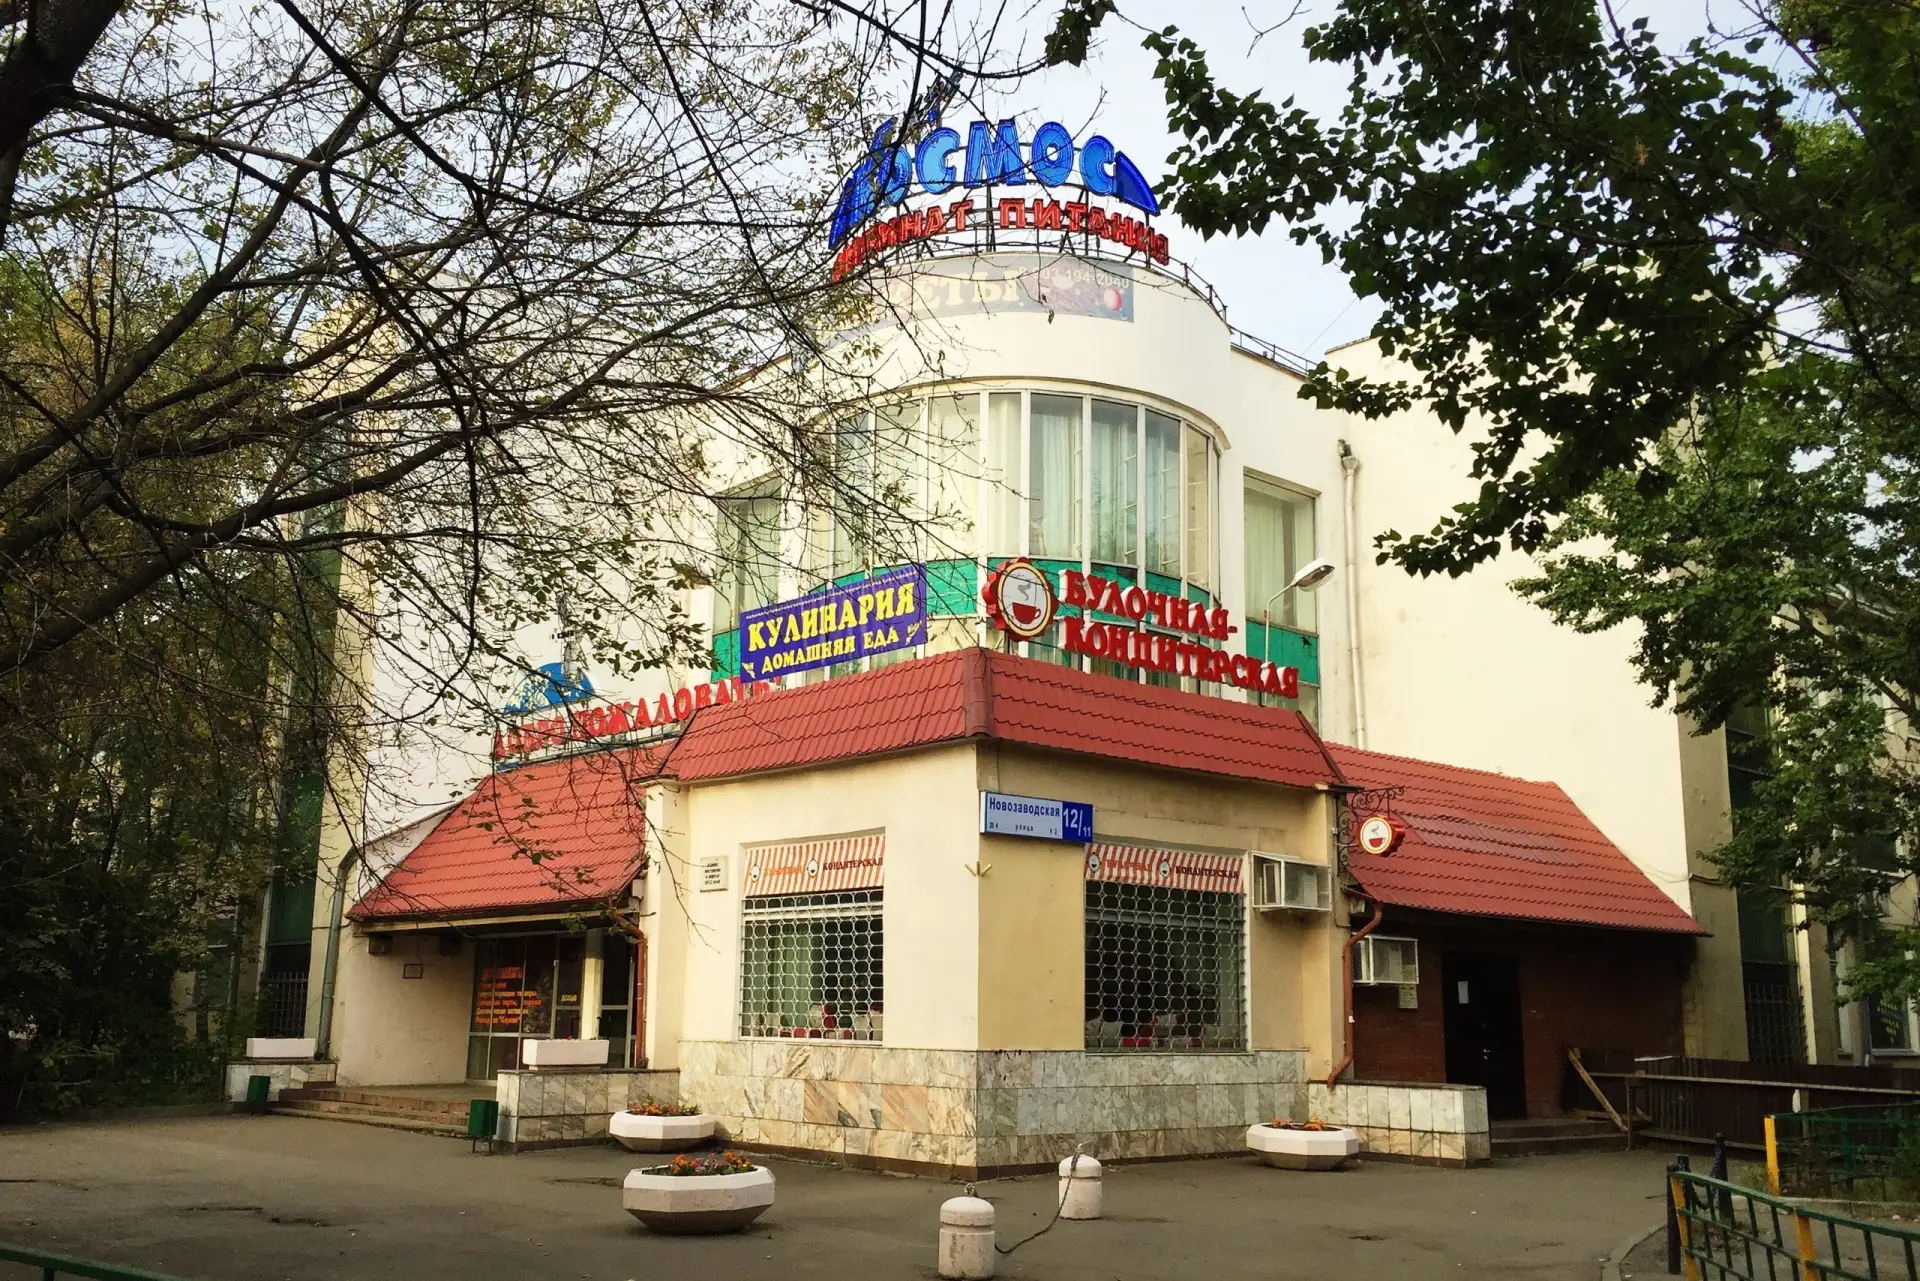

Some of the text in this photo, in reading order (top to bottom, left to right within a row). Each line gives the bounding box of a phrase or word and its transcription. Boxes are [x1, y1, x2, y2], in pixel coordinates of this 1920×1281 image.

[998, 197, 1169, 266] ПИТАНИЯ
[747, 582, 916, 652] КУЛИНАРИЯ
[1058, 568, 1238, 641] БУЛОЧНАЯ-
[761, 626, 900, 675] ДОМАШНЯЯ ЕДА
[1062, 616, 1299, 699] КОНДИТЕРСКАЯ
[988, 797, 1092, 837] Новозаводская 12/11
